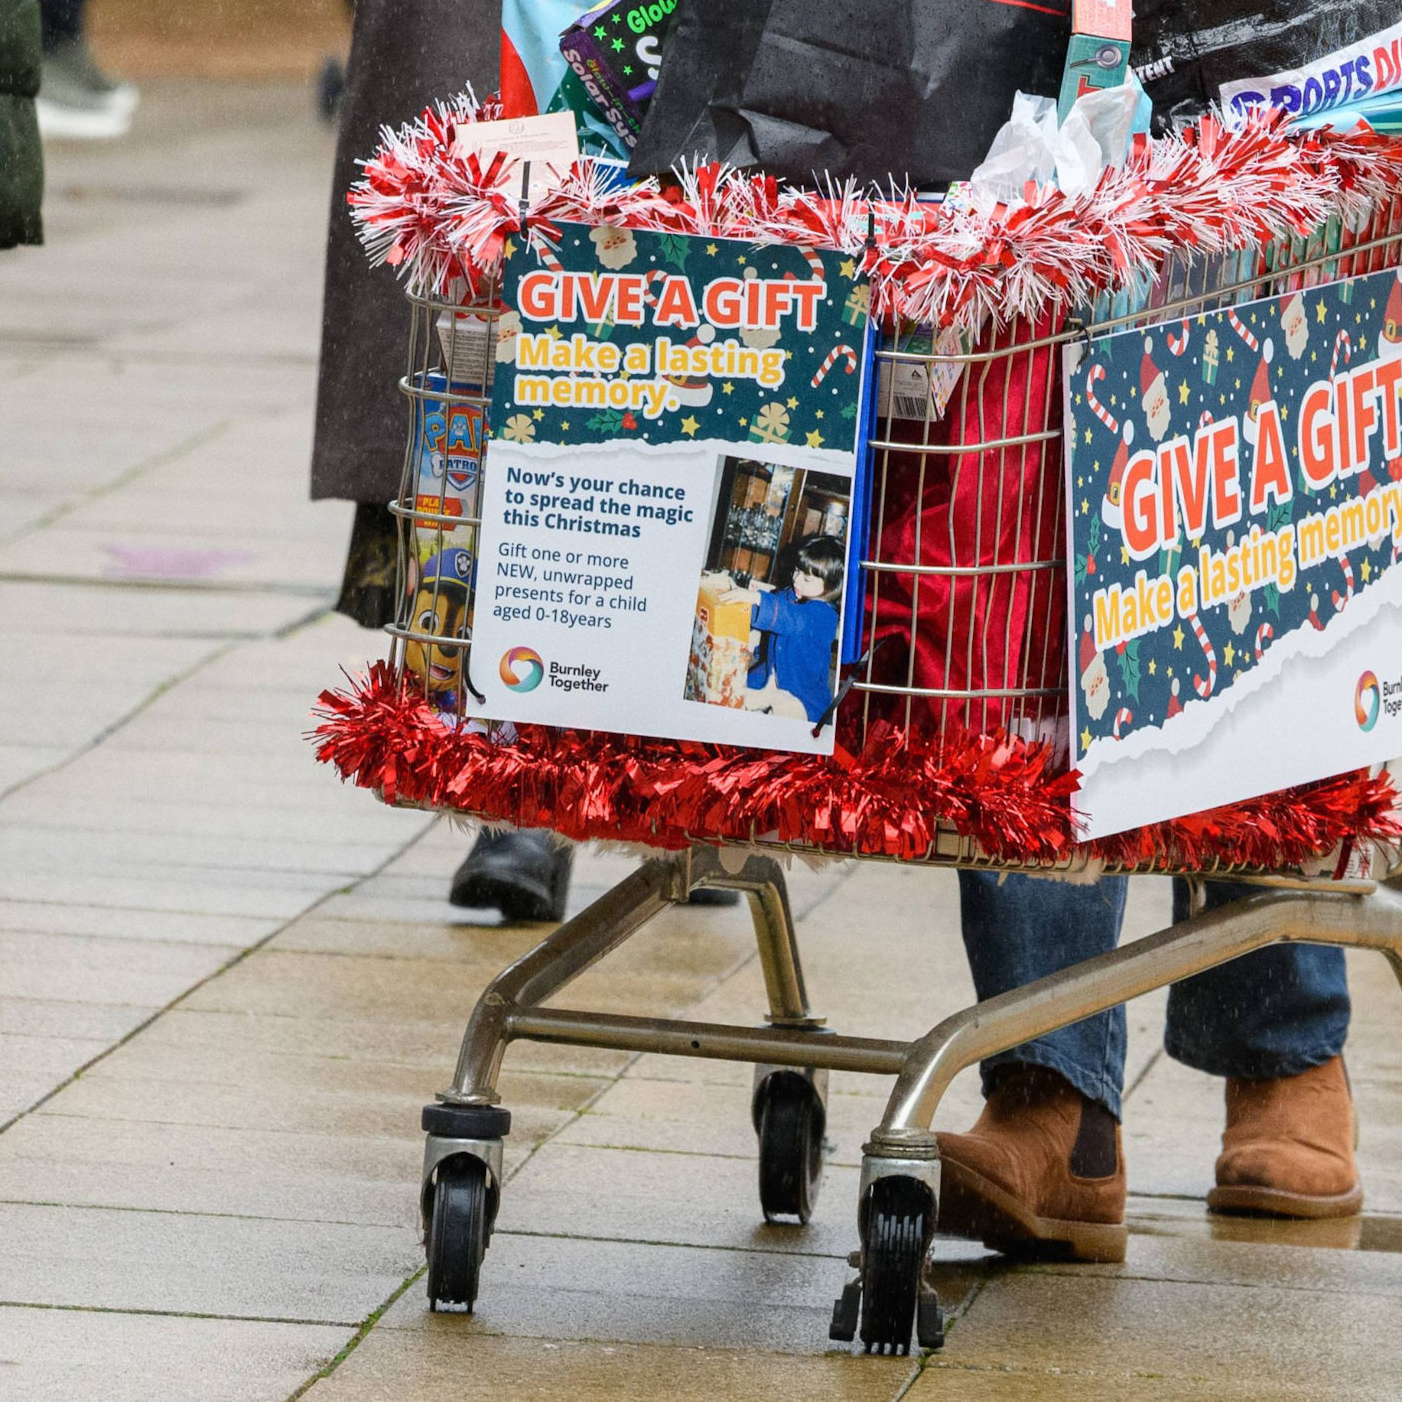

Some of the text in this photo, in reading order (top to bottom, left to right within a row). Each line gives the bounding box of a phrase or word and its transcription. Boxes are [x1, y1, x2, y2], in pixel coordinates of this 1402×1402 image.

[562, 48, 610, 113] Solar
[519, 272, 825, 328] GIVE A GIFT
[518, 335, 618, 372] Make
[625, 346, 648, 371] a
[659, 339, 784, 384] lasting
[516, 377, 681, 415] memory.
[506, 466, 686, 501] Now's your chance
[1122, 425, 1240, 553] GIVE
[1253, 409, 1290, 507] A
[503, 509, 642, 538] this Christmas
[504, 488, 694, 526] to spread the magic
[498, 541, 630, 570] Gift one or more
[496, 561, 635, 591] NEW, unwrapped
[1096, 574, 1172, 646] Make
[1179, 575, 1196, 614] a
[1202, 528, 1296, 604] lasting
[494, 584, 648, 613] presents for a child
[492, 604, 613, 630] aged 0-18years
[548, 673, 610, 693] Together
[549, 660, 602, 682] Burnley
